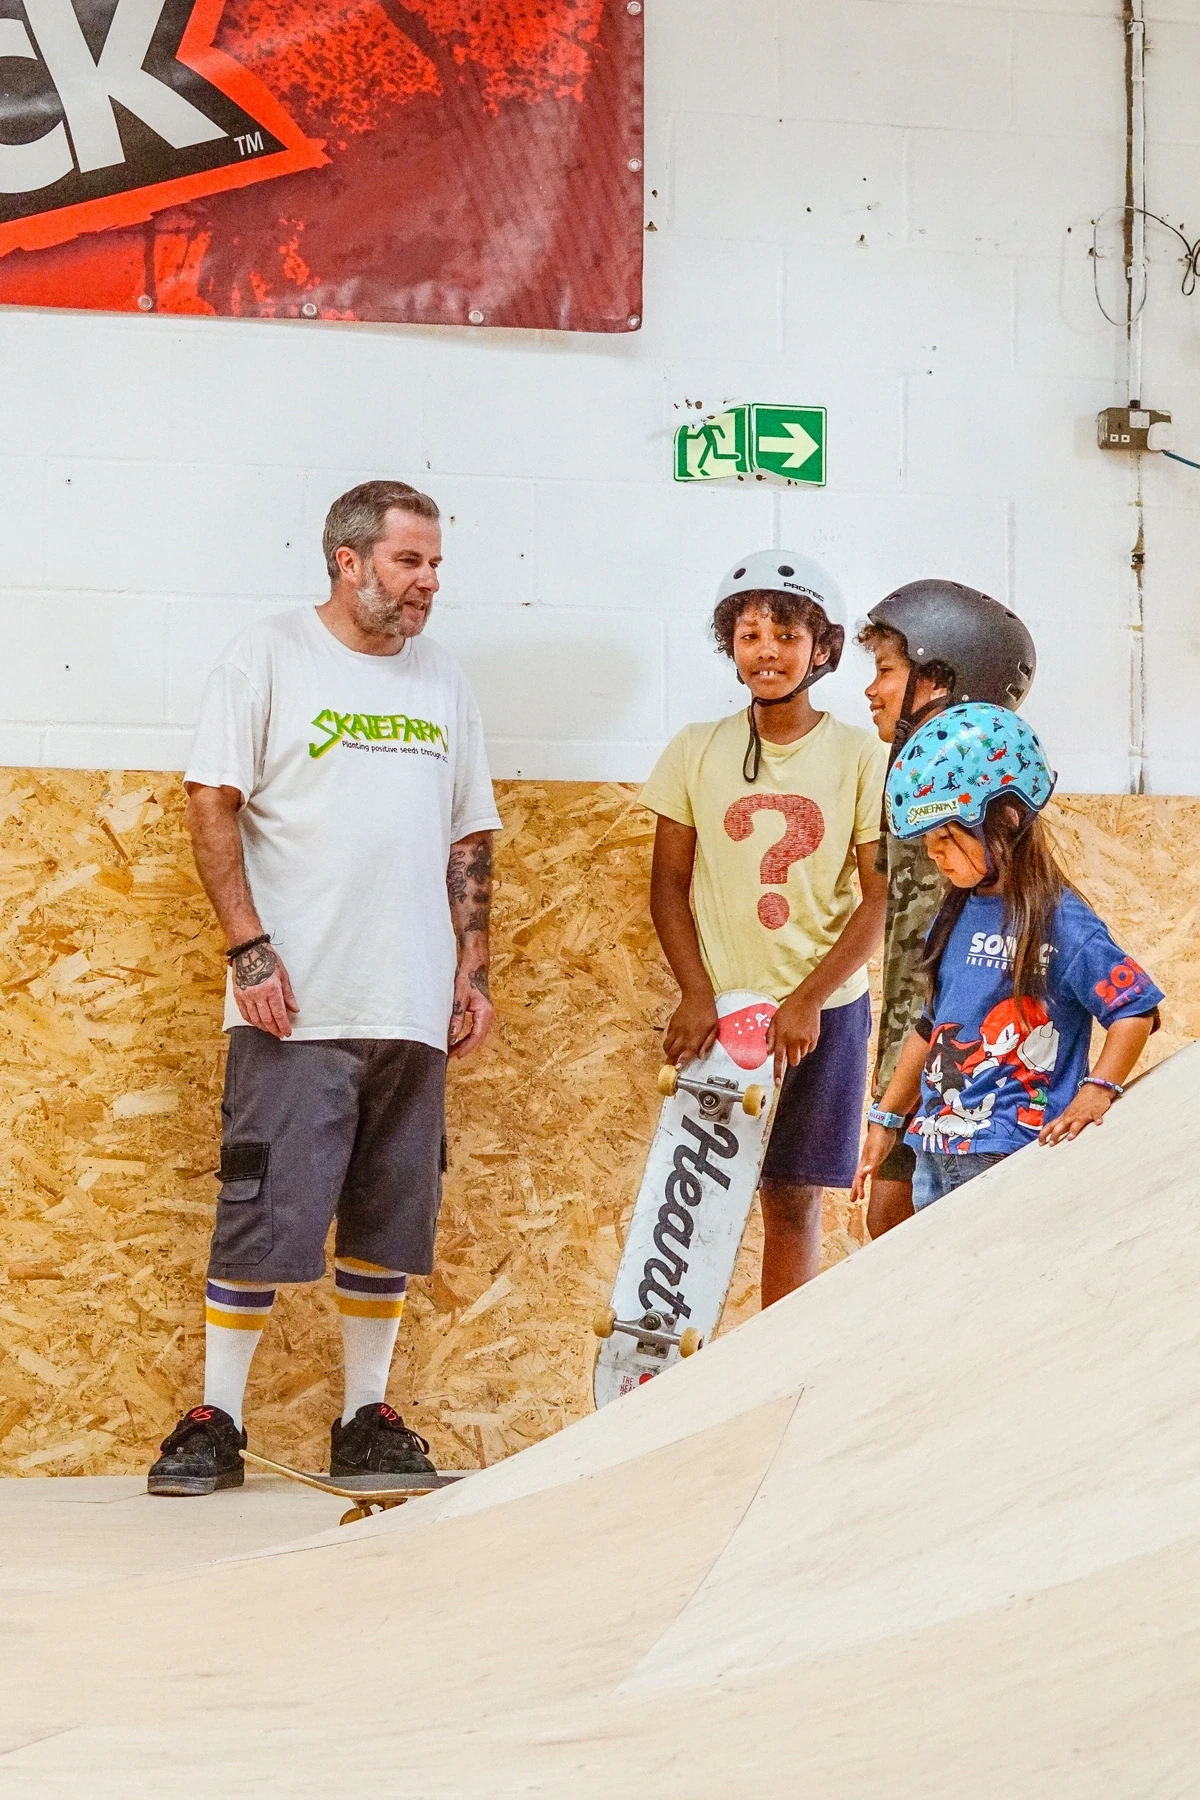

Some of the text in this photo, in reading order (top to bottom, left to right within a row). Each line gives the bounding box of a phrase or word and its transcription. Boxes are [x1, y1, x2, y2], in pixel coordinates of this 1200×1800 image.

[309, 708, 449, 759] SKATEFARM
[342, 740, 370, 752] Planting
[371, 745, 398, 753] positive
[966, 956, 983, 966] THE
[638, 1115, 740, 1320] Heart
